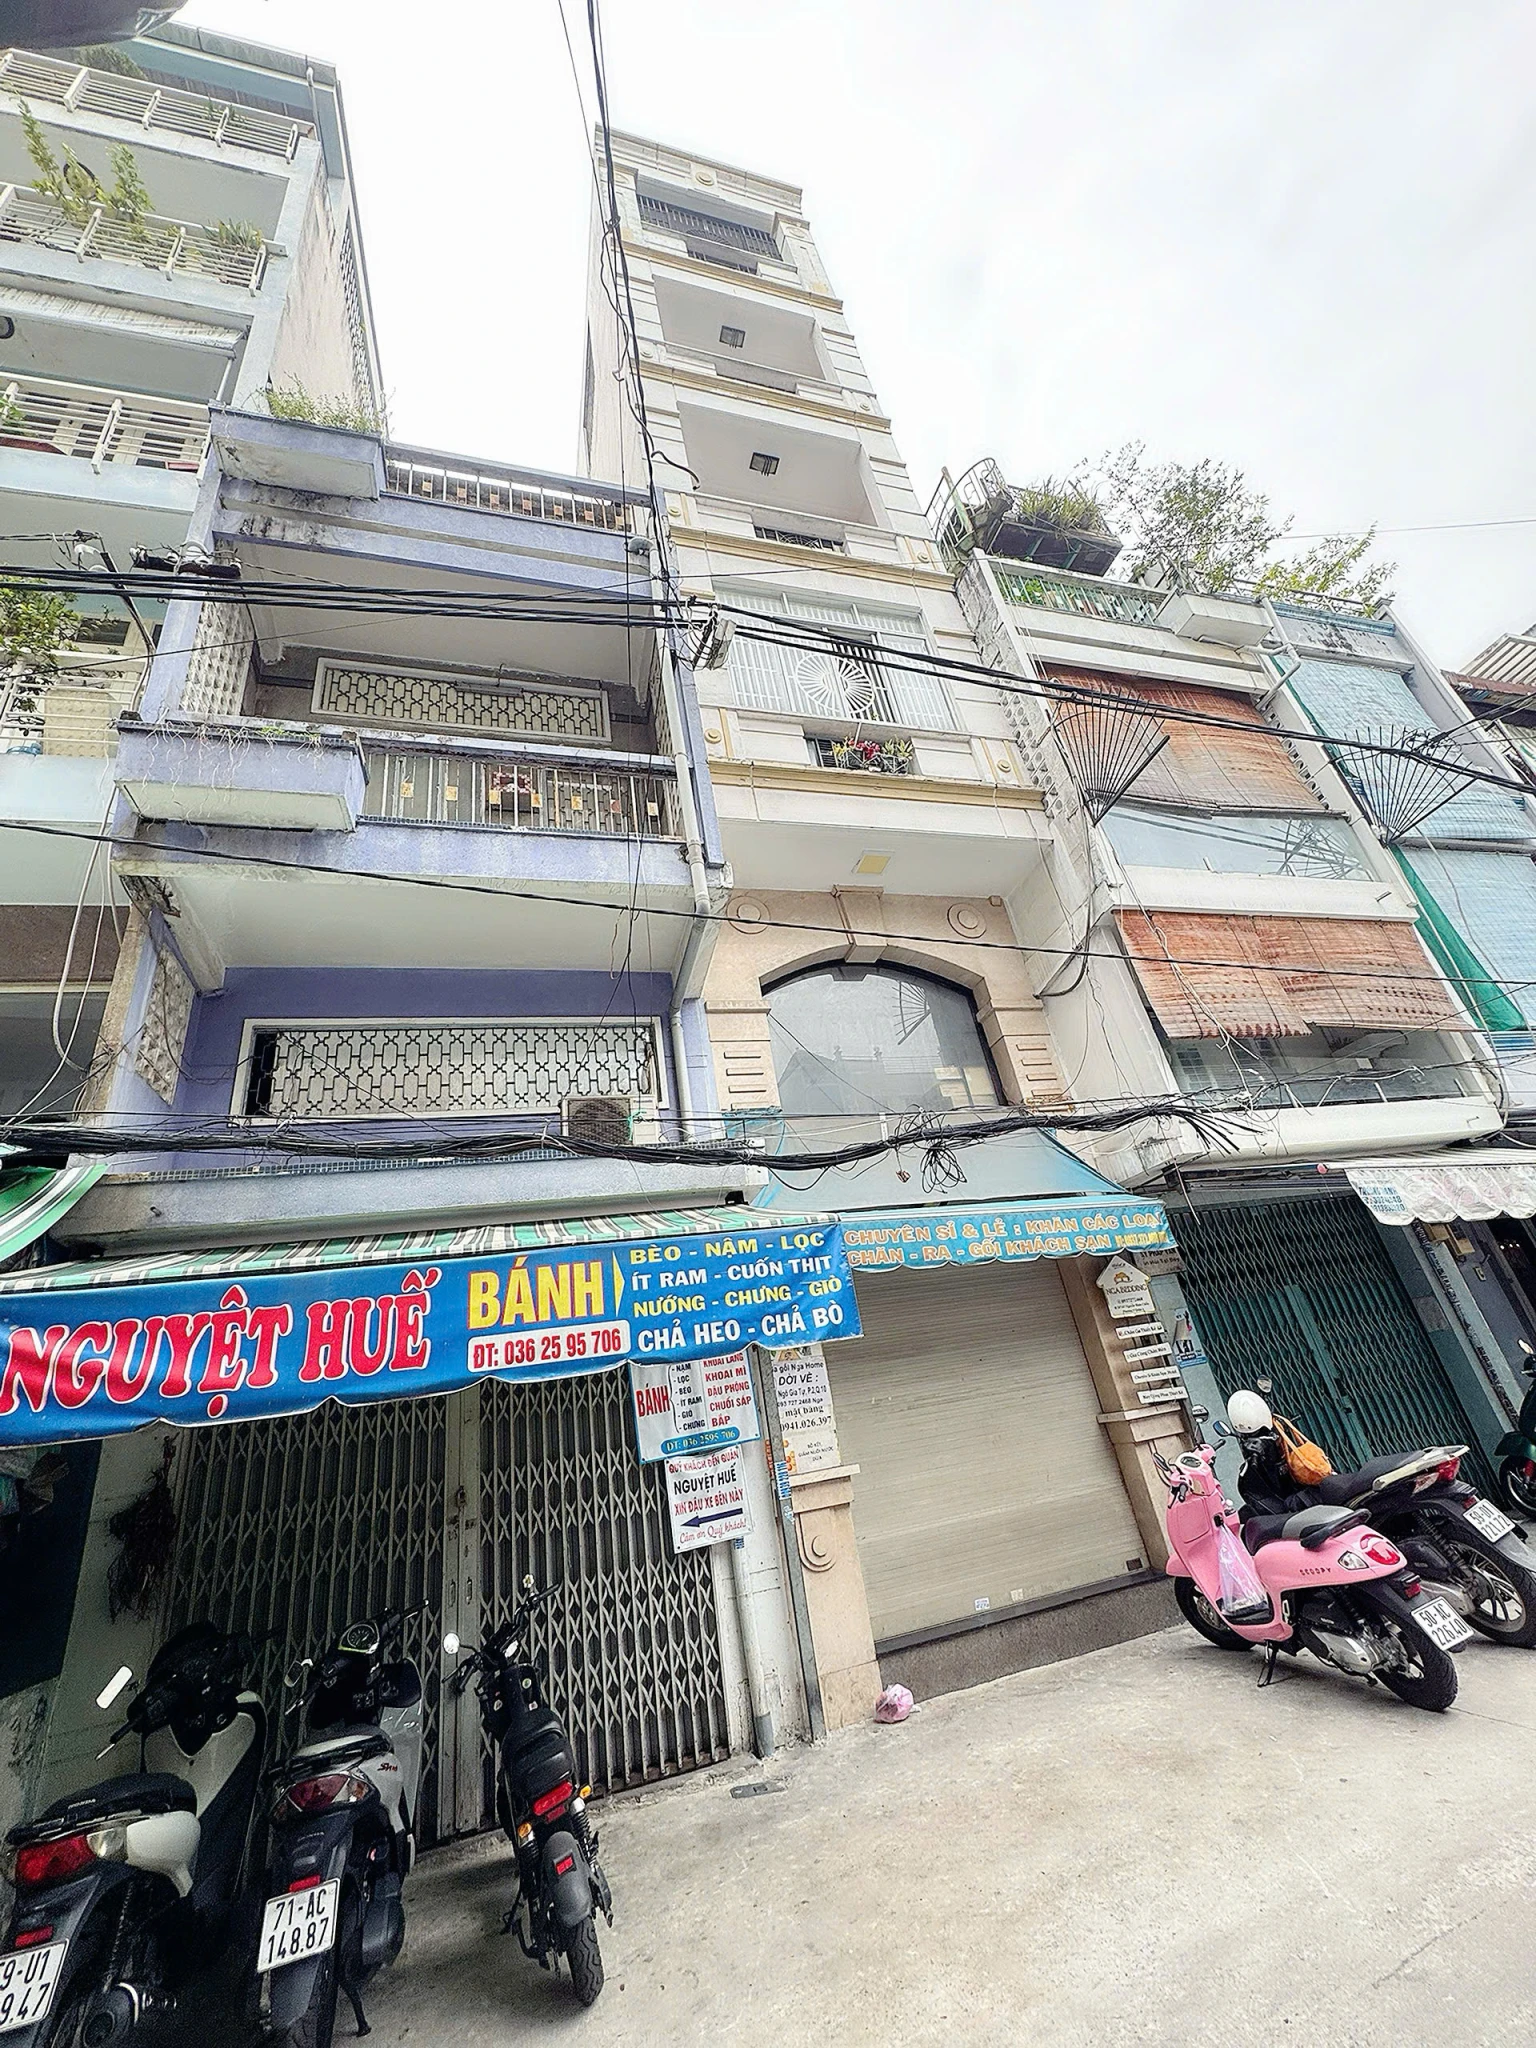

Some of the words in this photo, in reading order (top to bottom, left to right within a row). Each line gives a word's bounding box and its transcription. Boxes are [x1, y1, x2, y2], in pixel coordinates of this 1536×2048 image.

[844, 1224, 932, 1245] CHUYÊN
[962, 1224, 979, 1239] &
[982, 1217, 1007, 1238] LẺ
[1025, 1216, 1079, 1235] KHĂN
[1081, 1213, 1118, 1231] CÁC
[630, 1244, 681, 1265] BÈO
[705, 1237, 758, 1259] NẬM
[780, 1232, 825, 1253] LỌC
[847, 1246, 905, 1267] CHĂN
[922, 1244, 952, 1261] RA
[968, 1237, 1002, 1257] GỐI
[1005, 1234, 1074, 1256] KHÁCH
[1074, 1233, 1112, 1253] SẠN
[631, 1271, 651, 1291] ÍT
[659, 1268, 707, 1289] RAM
[727, 1256, 784, 1281] CUỐN
[788, 1255, 832, 1275] THỊT
[468, 1255, 605, 1330] BÁNH
[633, 1295, 706, 1318] NƯỚNG
[724, 1284, 792, 1308] CHƯNG
[809, 1275, 843, 1297] GIÒ
[637, 1319, 686, 1352] CHẢ
[694, 1319, 741, 1345] HEO
[761, 1306, 807, 1336] CHẢ
[812, 1300, 844, 1327] BÒ
[0, 1285, 293, 1418] NGUYỆT
[299, 1268, 442, 1383] HUẾ
[473, 1342, 499, 1369] ĐT:
[504, 1338, 536, 1366] 036
[541, 1335, 562, 1361] 25
[566, 1332, 586, 1357] 95
[591, 1327, 622, 1354] 706
[705, 1370, 733, 1382] KHOAI
[735, 1364, 747, 1377] MÌ
[805, 1361, 824, 1369] Home
[636, 1383, 671, 1418] BÁNH
[688, 1395, 703, 1406] RAM
[735, 1395, 752, 1407] SÁP
[682, 1437, 698, 1447] 036
[700, 1433, 719, 1444] 2595
[721, 1430, 736, 1440] 706
[673, 1473, 715, 1495] NGUYỆT
[717, 1462, 737, 1486] HUẾ
[683, 1459, 707, 1472] KHÁCH
[674, 1500, 687, 1516] XIN
[704, 1496, 714, 1508] XE
[714, 1490, 728, 1506] BÊN
[729, 1487, 744, 1503] NÀY
[1431, 1618, 1468, 1646] 226.40
[273, 1888, 327, 1931] 71-AC
[268, 1916, 330, 1964] 148.87
